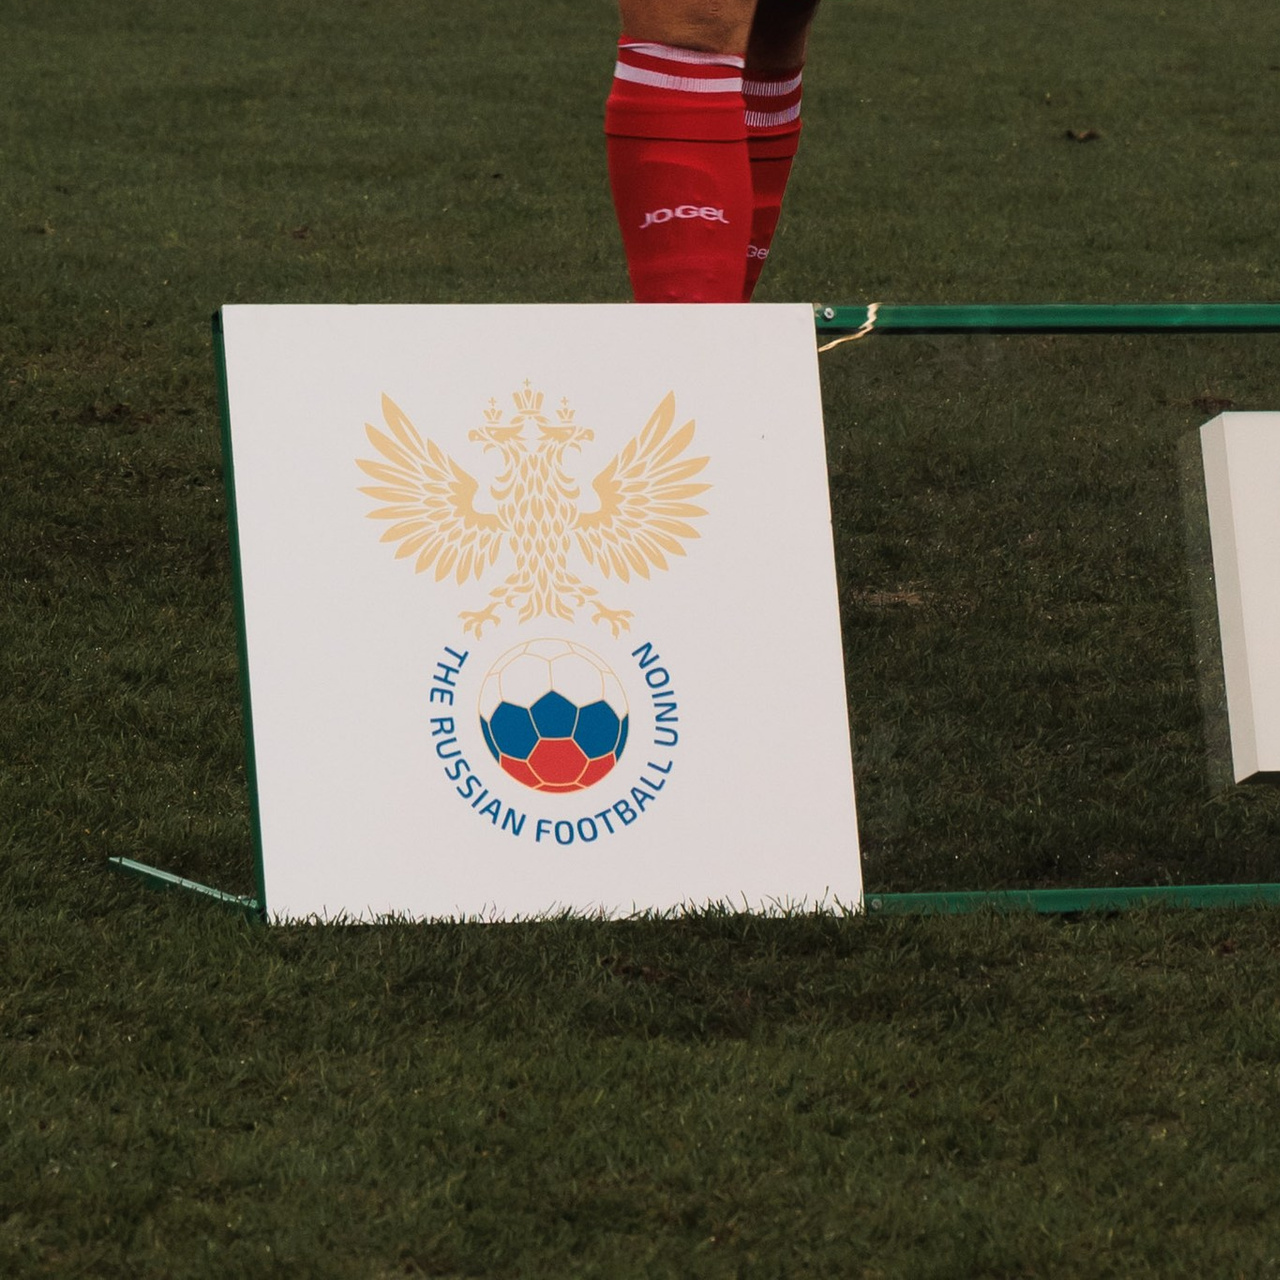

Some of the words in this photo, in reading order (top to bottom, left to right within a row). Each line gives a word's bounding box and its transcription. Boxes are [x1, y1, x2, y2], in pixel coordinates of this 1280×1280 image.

[429, 646, 469, 706] THE
[631, 642, 679, 747] UNION
[429, 716, 526, 837] RUSSIAN
[535, 760, 673, 846] FOOTBALL
